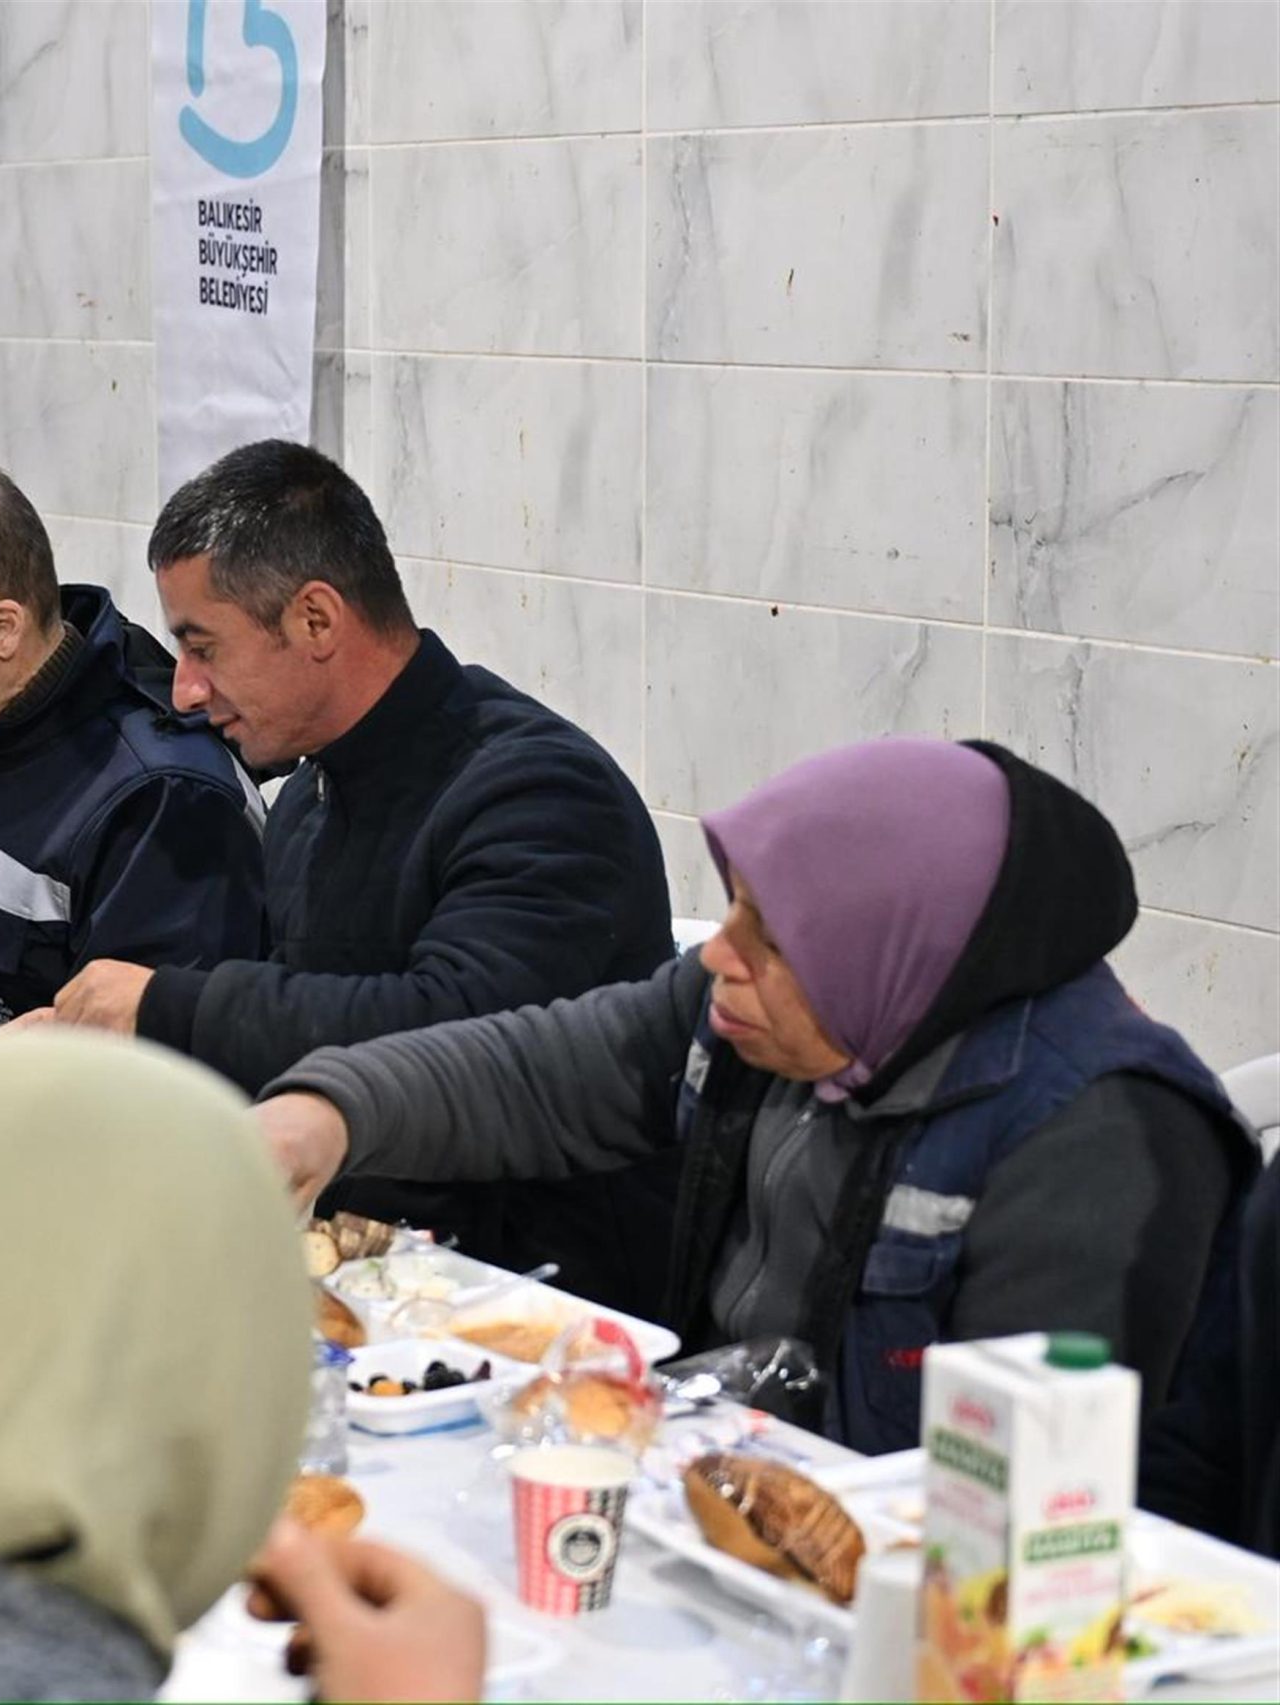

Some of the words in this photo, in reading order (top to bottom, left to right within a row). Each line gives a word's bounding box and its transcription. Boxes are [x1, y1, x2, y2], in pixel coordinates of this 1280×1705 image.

[198, 199, 262, 233] BALIKESİR
[199, 233, 277, 276] BÜYÜKŞEHİR
[200, 276, 268, 315] BELEDİYESİ
